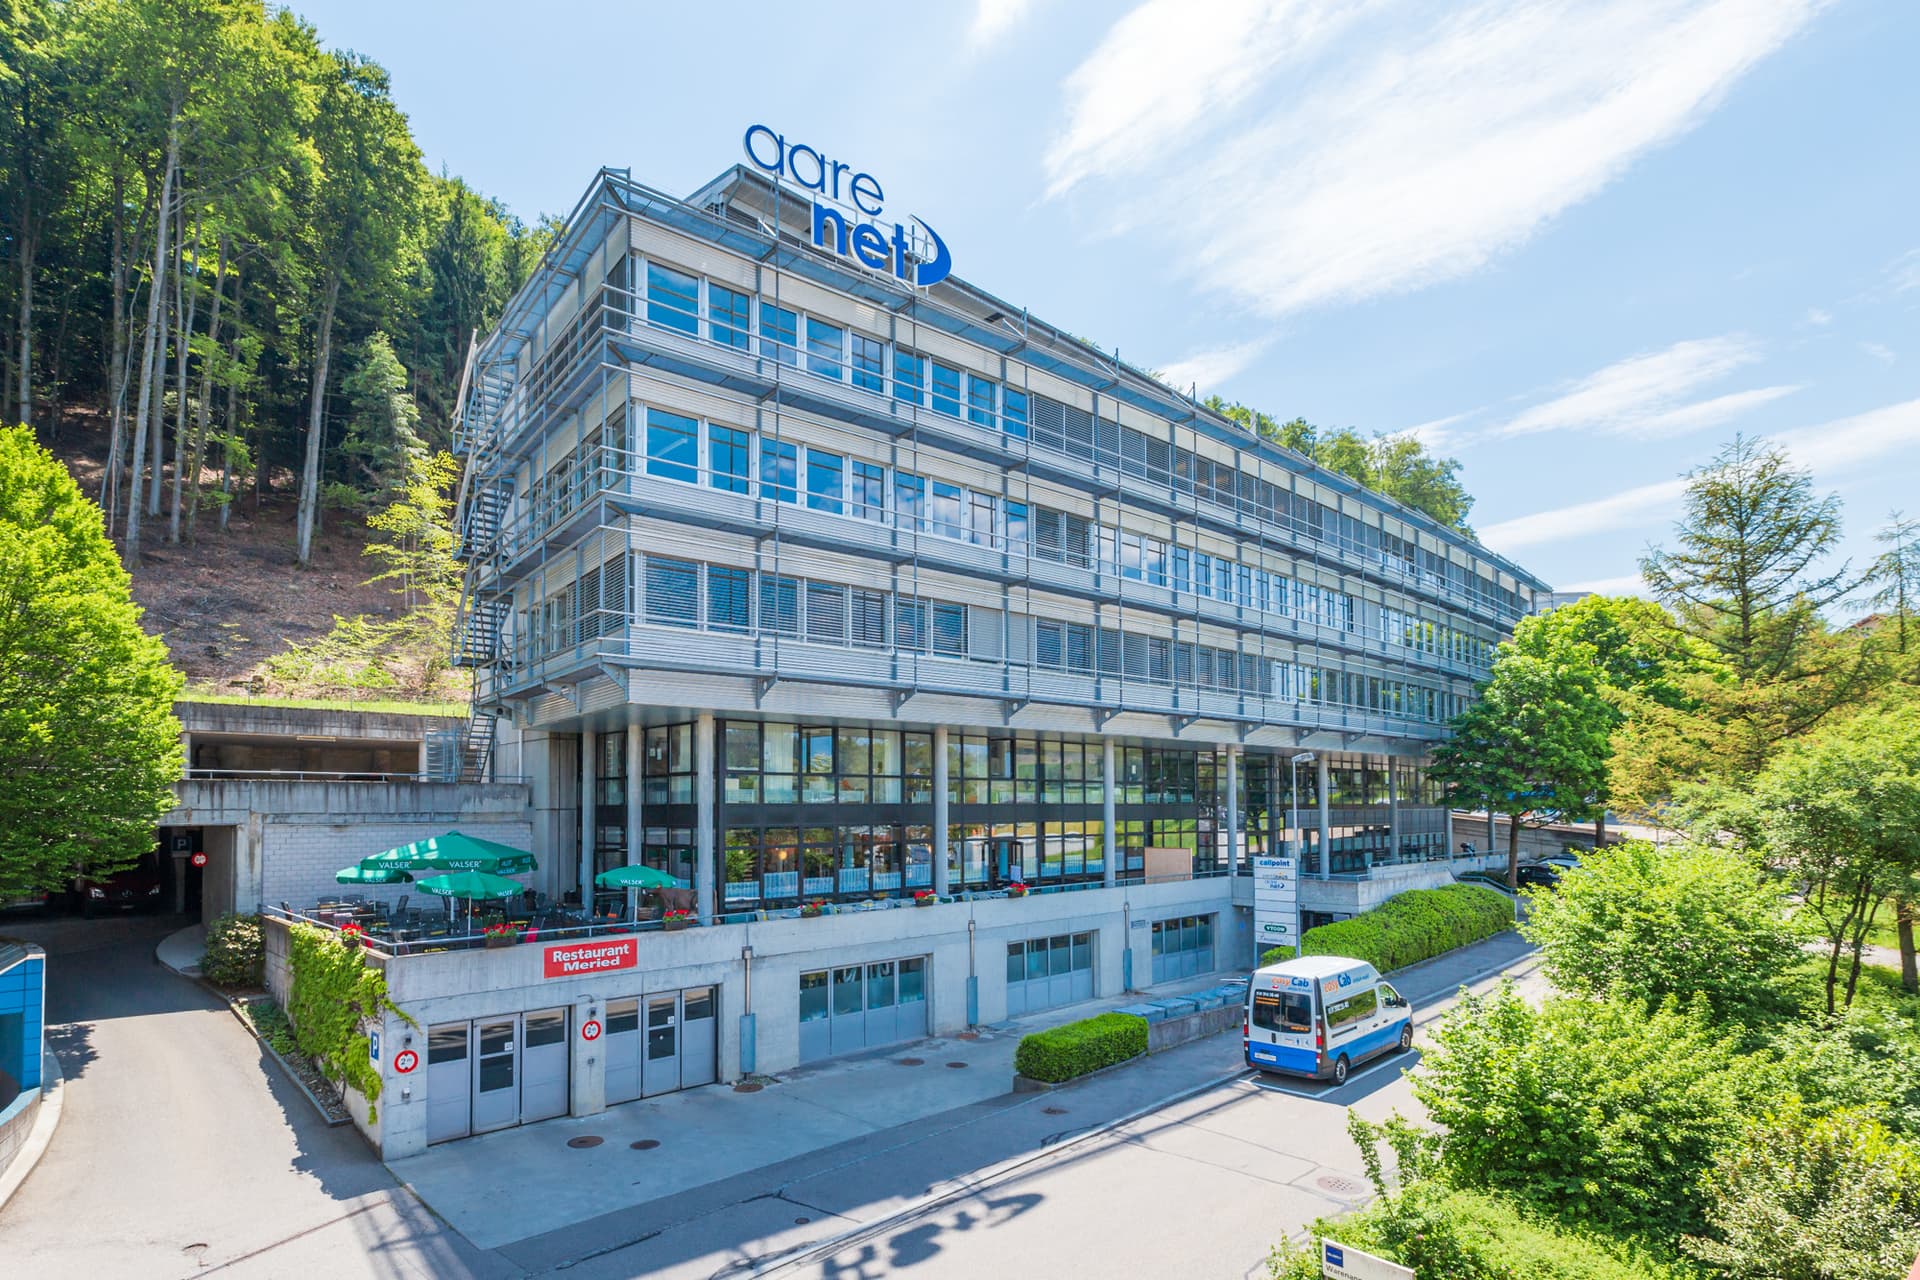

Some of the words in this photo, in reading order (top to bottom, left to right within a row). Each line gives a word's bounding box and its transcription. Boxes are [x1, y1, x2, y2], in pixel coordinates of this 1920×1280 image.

[744, 124, 885, 217] aare
[810, 202, 909, 280] net
[177, 839, 187, 849] P
[378, 861, 411, 869] VALSER
[448, 860, 481, 868] VALSER
[1259, 859, 1290, 867] callpoint
[431, 887, 453, 896] VALSER
[496, 889, 513, 897] VALSER
[552, 943, 630, 963] Restaurant
[563, 956, 621, 972] Meried
[1271, 977, 1290, 986] easy
[1291, 976, 1309, 987] Cab
[1323, 979, 1339, 993] easy
[1337, 972, 1352, 988] Cab
[372, 1035, 378, 1056] P
